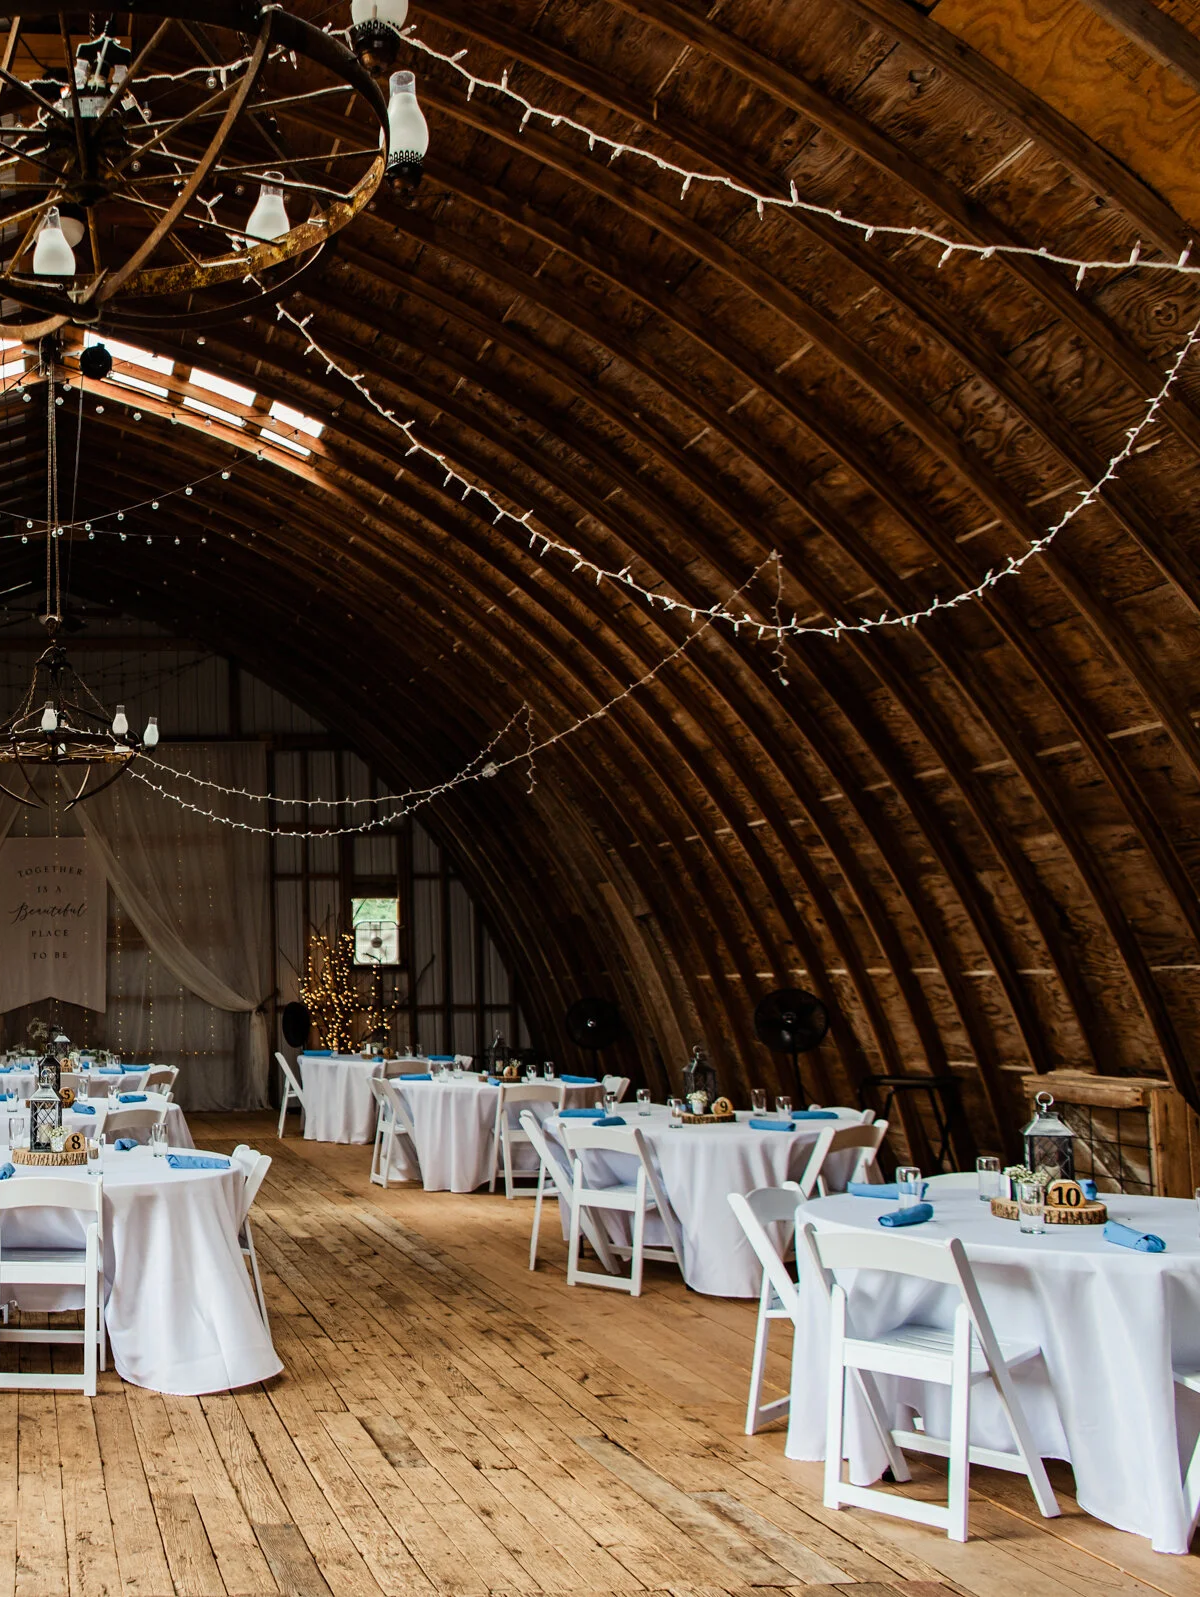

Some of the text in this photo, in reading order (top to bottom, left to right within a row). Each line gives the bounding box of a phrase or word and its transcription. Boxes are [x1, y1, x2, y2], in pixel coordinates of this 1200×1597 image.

[17, 866, 83, 878] TOGETHER
[56, 885, 62, 893] A
[8, 902, 85, 925] Beautiful
[31, 929, 69, 937] PLACE
[32, 951, 69, 960] TO BE
[63, 1059, 69, 1067] 2
[64, 1089, 71, 1099] 5
[720, 1100, 728, 1113] 9
[71, 1135, 81, 1150] 8
[1052, 1186, 1081, 1207] 10
